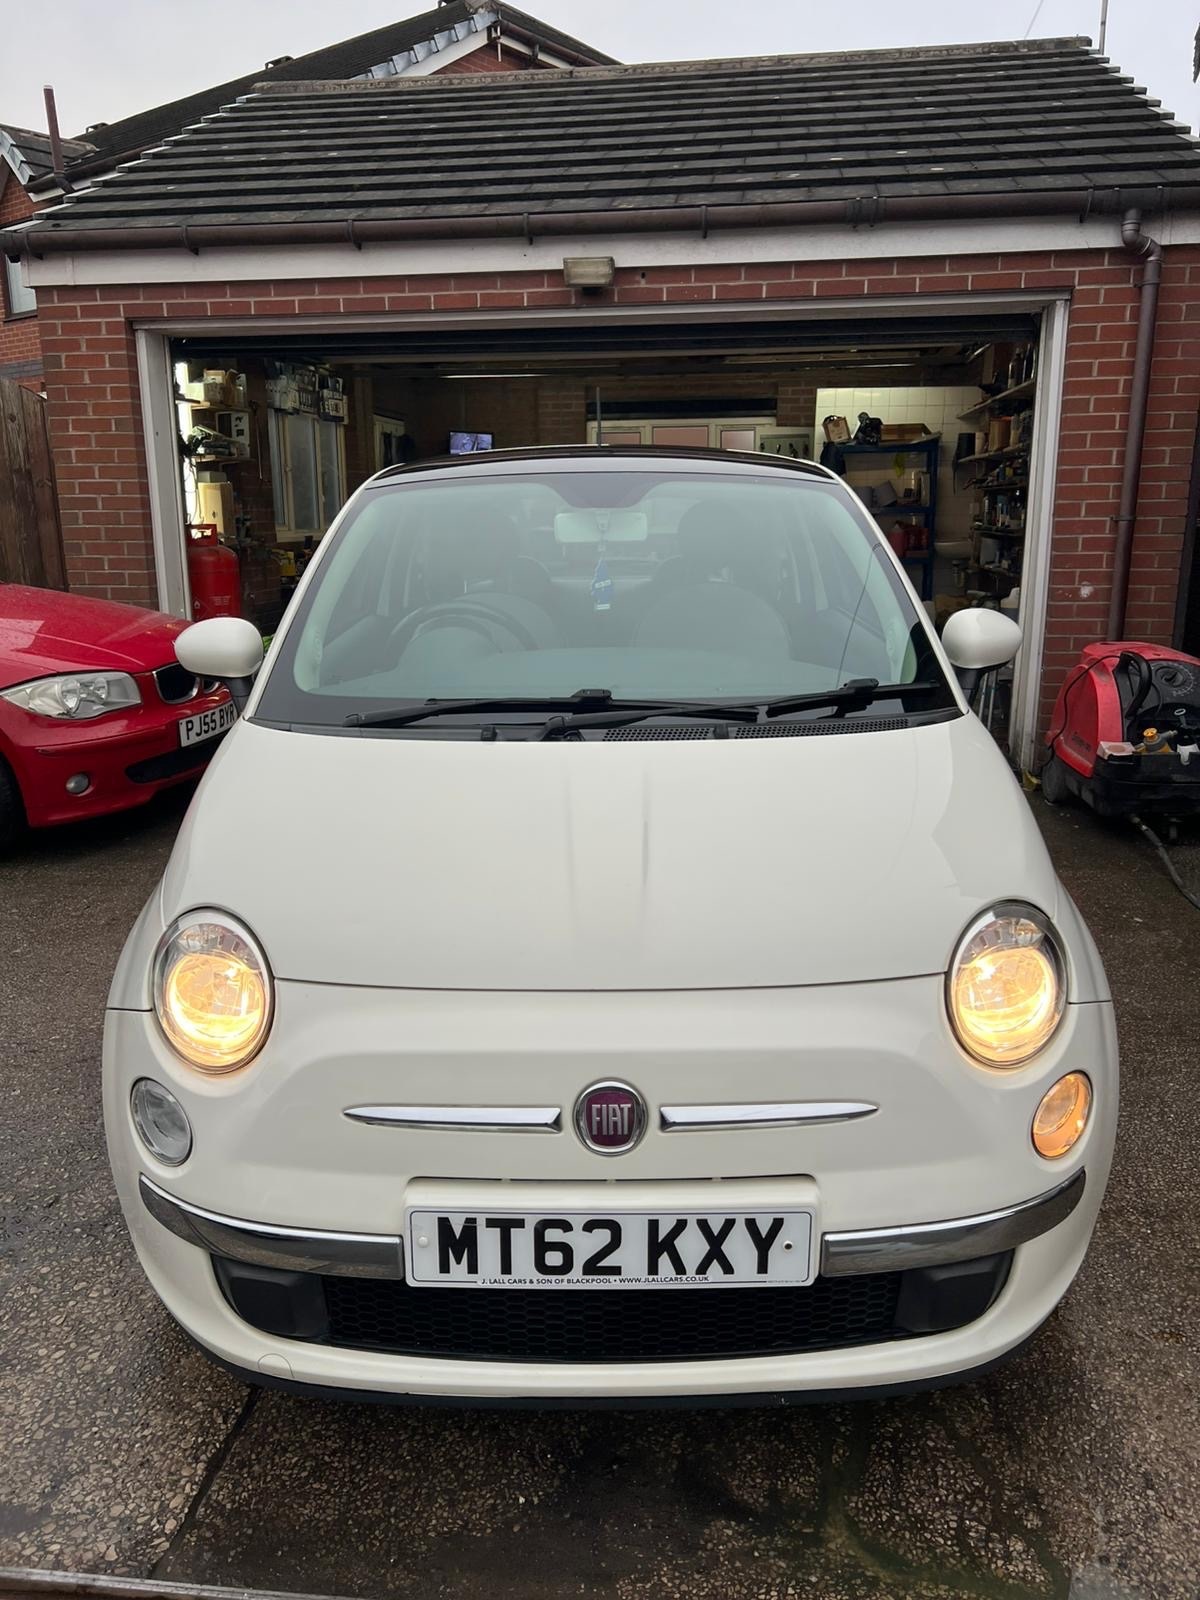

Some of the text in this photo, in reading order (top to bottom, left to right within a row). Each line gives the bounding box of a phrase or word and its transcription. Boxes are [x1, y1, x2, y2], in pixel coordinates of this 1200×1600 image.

[186, 703, 235, 740] PJ55 BYR
[591, 1103, 632, 1136] FIAT
[437, 1217, 785, 1276] MT62 KXY
[566, 1277, 612, 1285] BLACKPOOL
